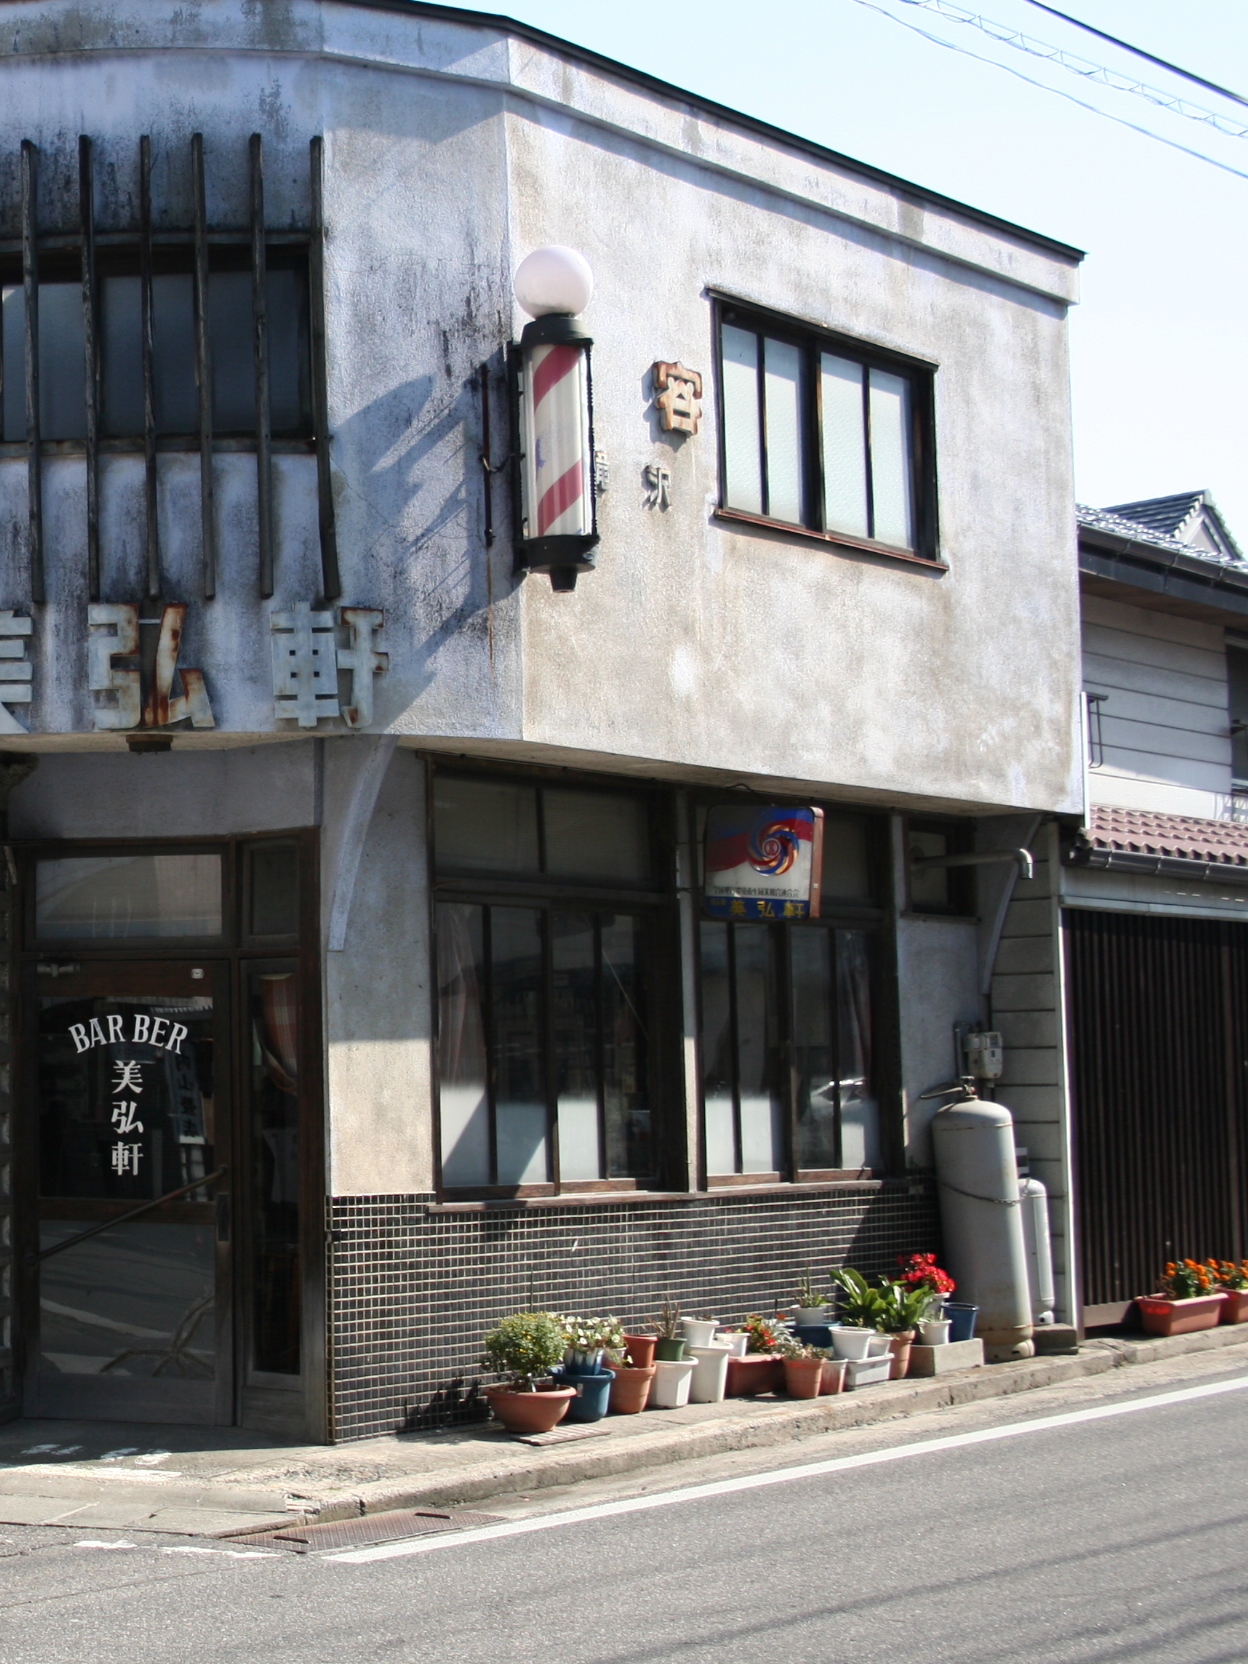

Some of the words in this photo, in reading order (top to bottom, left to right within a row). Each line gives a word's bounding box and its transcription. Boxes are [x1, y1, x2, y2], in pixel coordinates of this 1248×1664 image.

[730, 900, 805, 918] 美弘軒
[111, 1060, 144, 1176] 美弘軒
